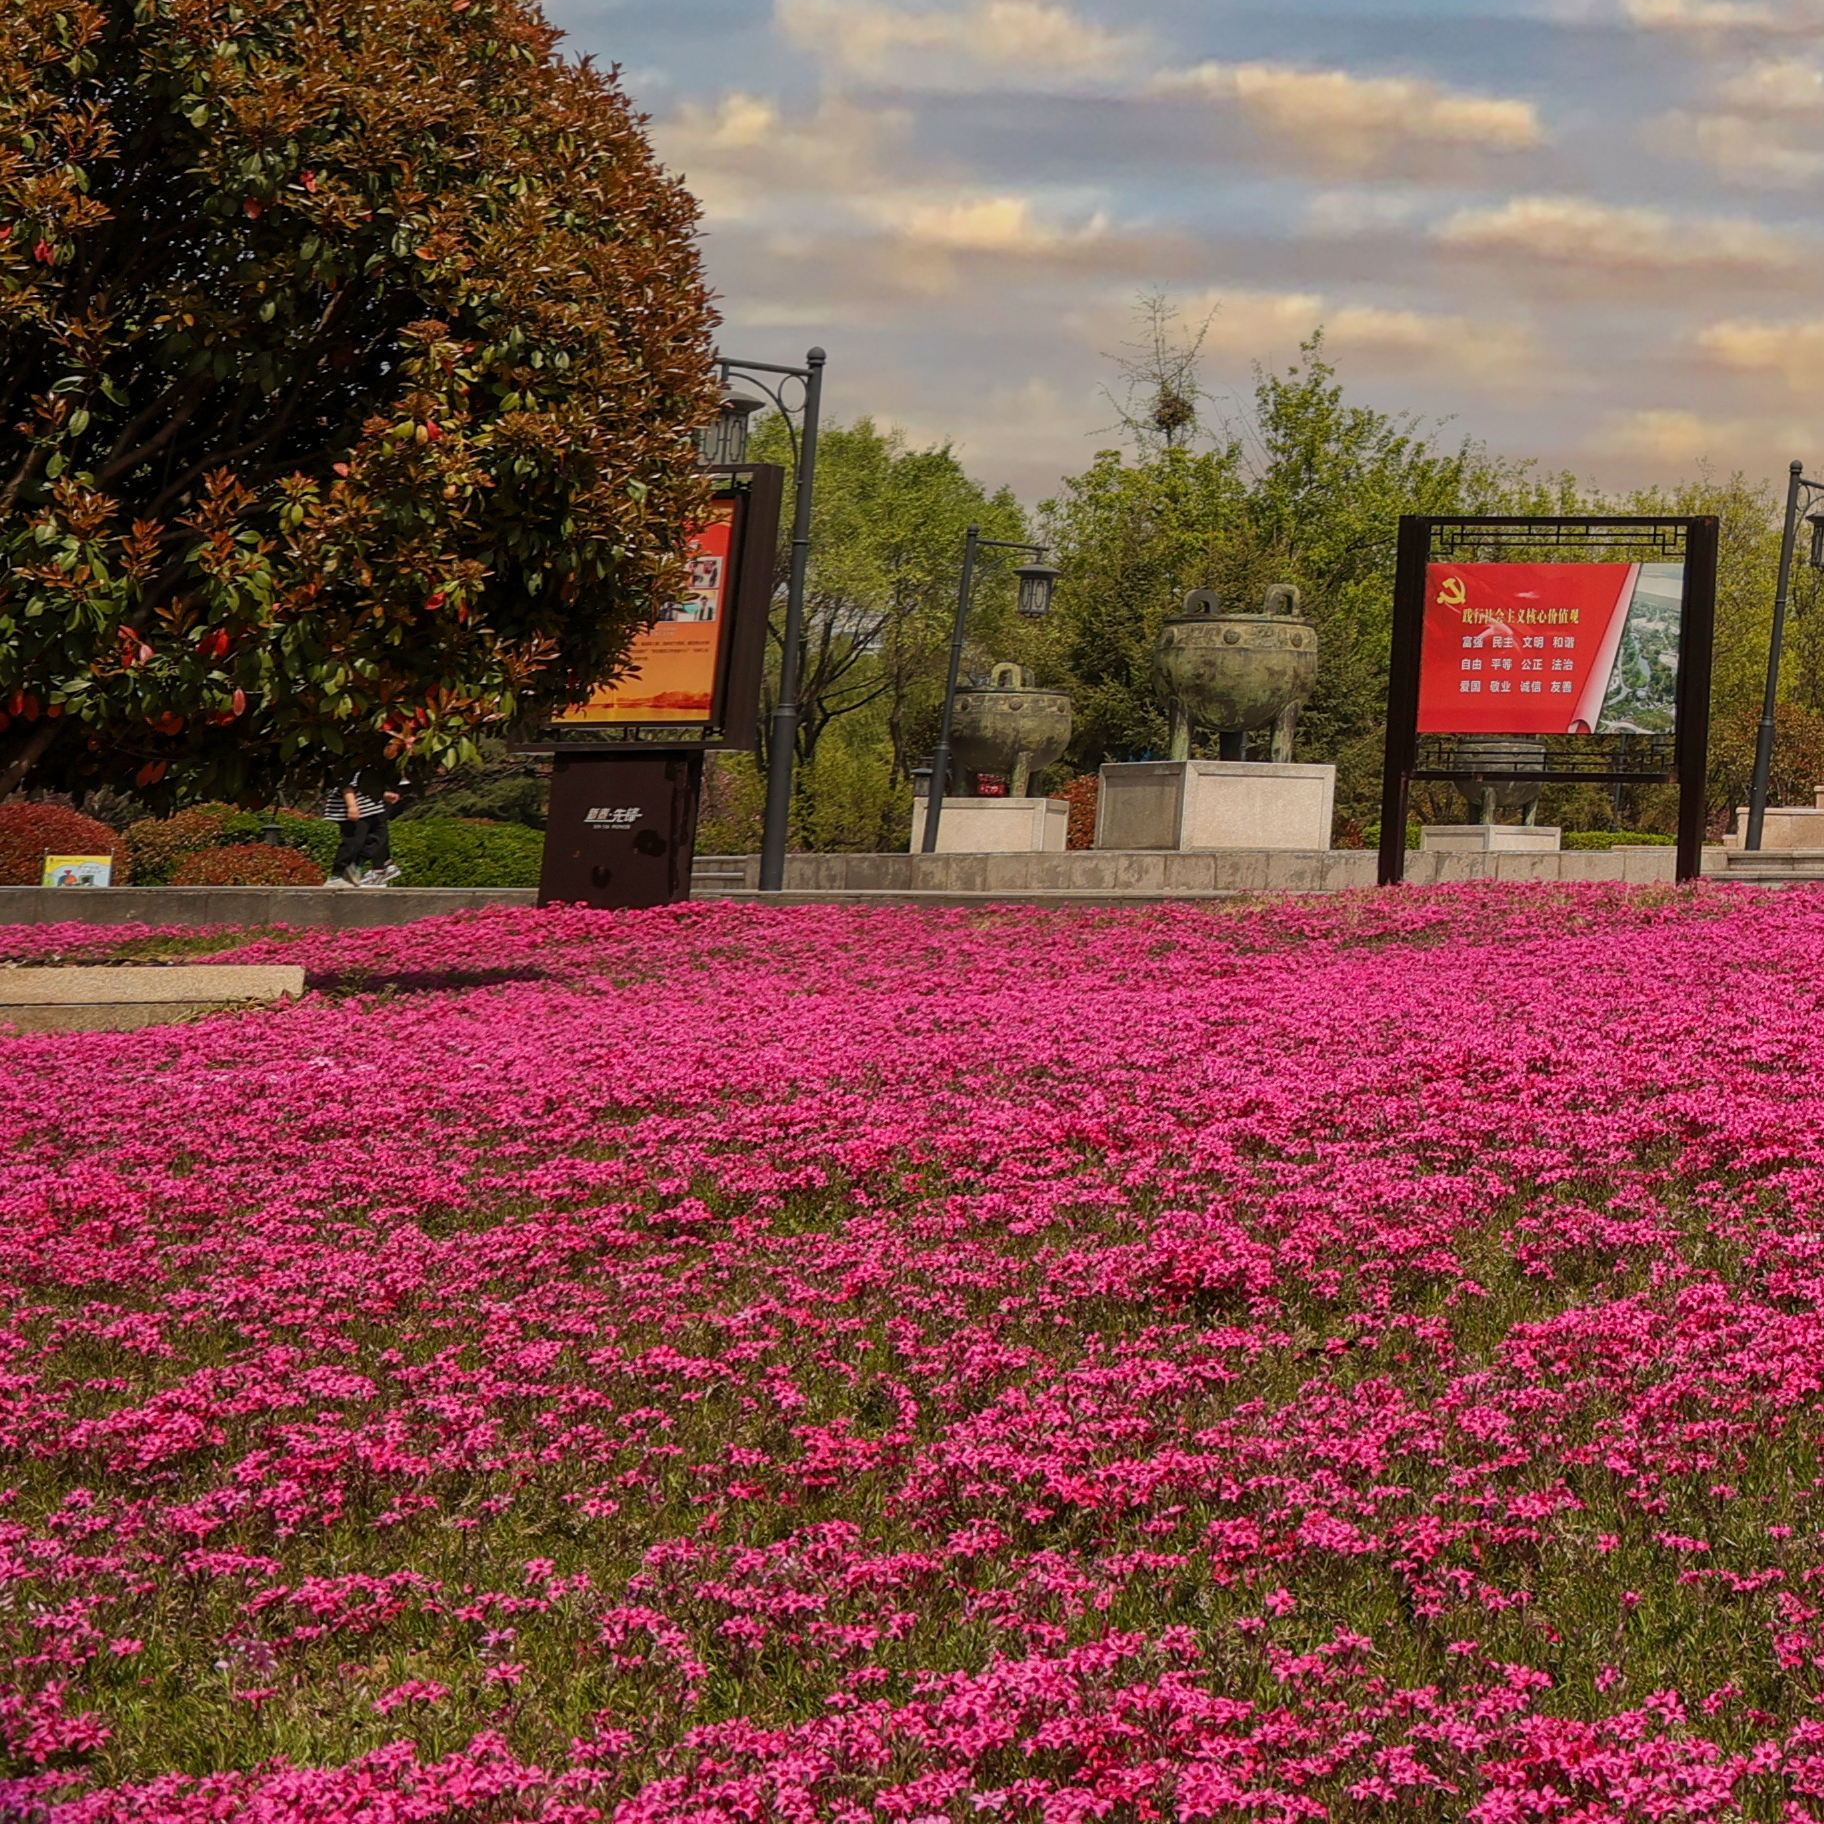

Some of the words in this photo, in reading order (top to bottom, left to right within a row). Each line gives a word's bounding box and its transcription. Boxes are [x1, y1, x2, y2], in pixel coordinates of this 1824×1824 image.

[1461, 608, 1580, 625] 践行社会主义核心价值观
[1462, 636, 1484, 648] 富强
[1492, 636, 1514, 648] 民主
[1522, 636, 1544, 648] 文明
[1552, 636, 1575, 649] 和谐
[1461, 658, 1482, 670] 自由
[1491, 658, 1513, 670] 平等
[1521, 658, 1543, 670] 公正
[1551, 658, 1574, 670] 法治
[1460, 680, 1481, 693] 爱国
[1489, 680, 1511, 693] 敬业
[1520, 681, 1541, 693] 诚信
[1550, 681, 1572, 693] 友善
